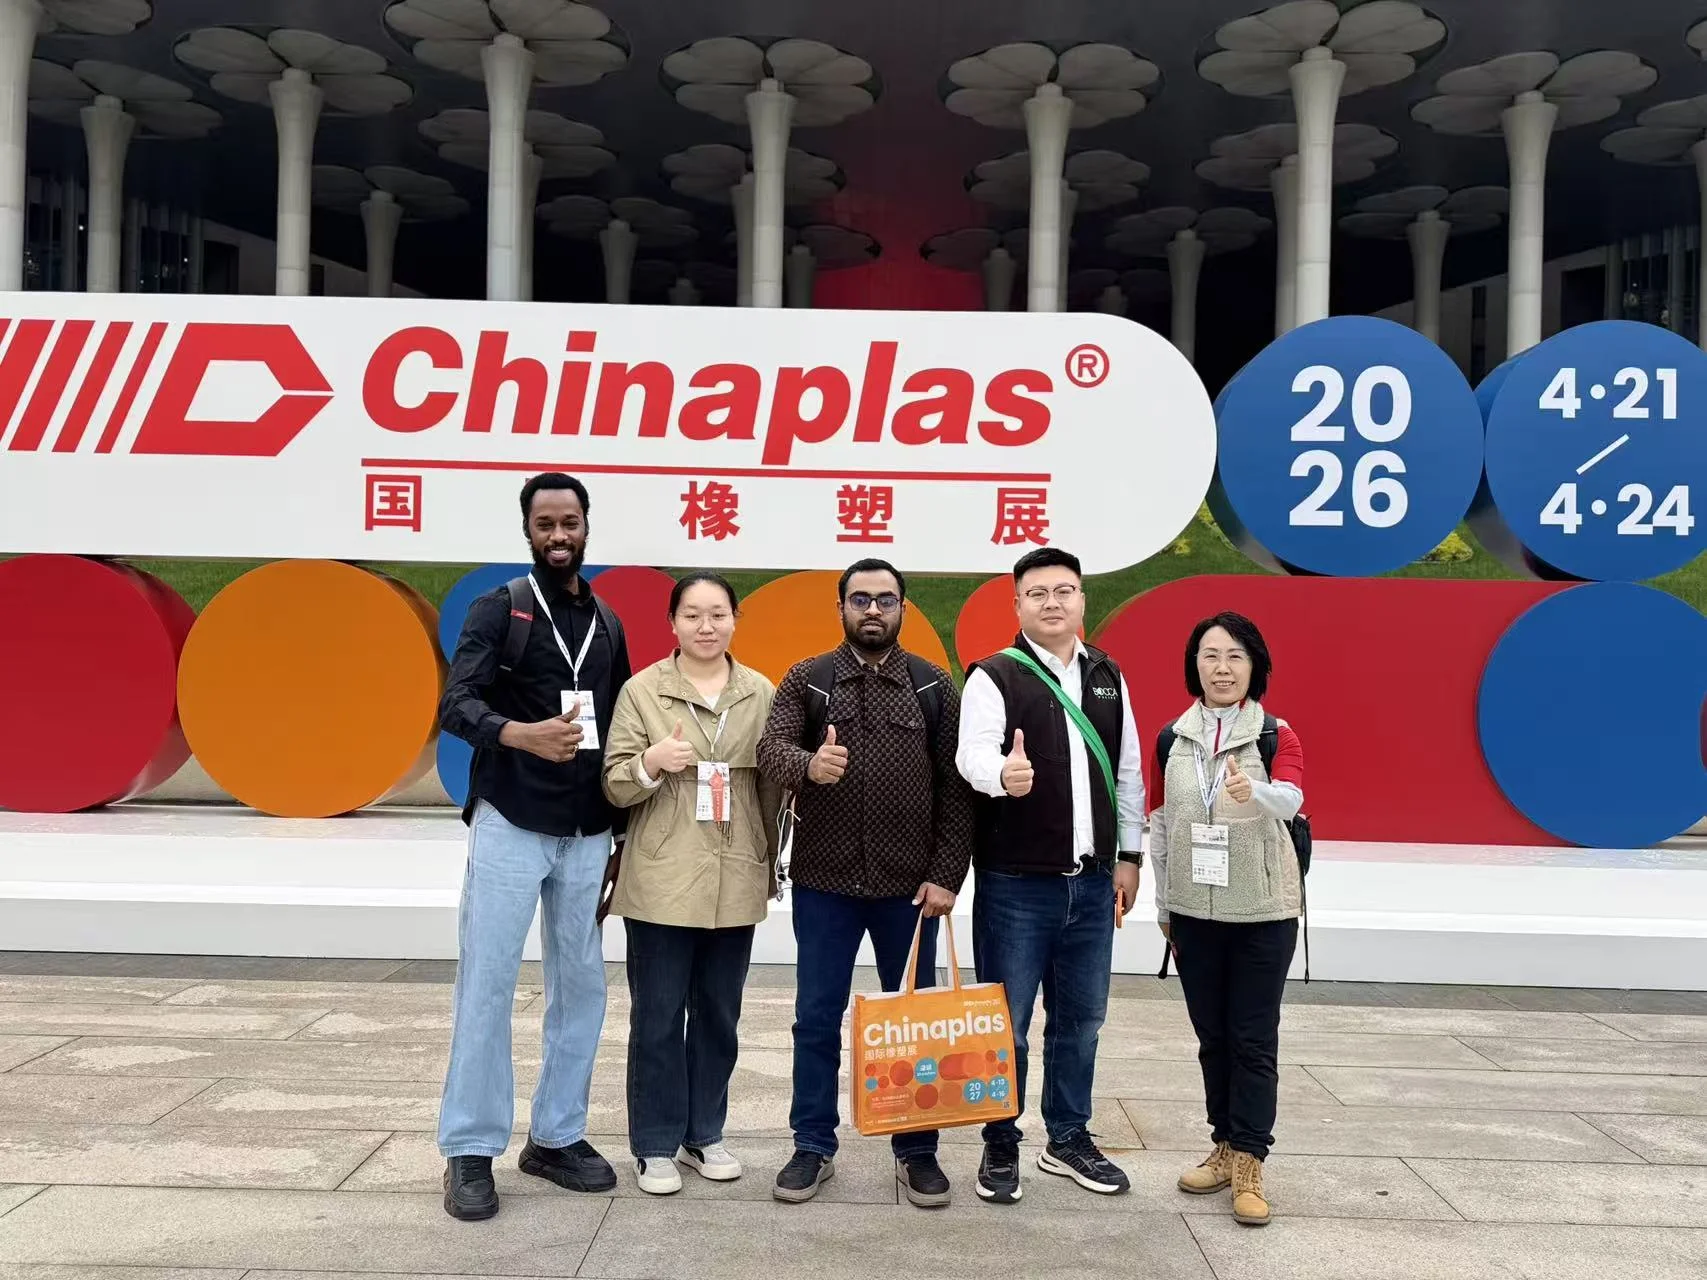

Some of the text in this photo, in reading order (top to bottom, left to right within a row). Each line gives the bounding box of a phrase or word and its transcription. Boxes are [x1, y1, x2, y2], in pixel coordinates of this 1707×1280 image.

[1290, 365, 1412, 443] 20
[1539, 366, 1678, 420] 4·21
[1289, 449, 1409, 528] 26
[1539, 482, 1696, 537] 4·24
[968, 1082, 982, 1092] 20
[969, 1091, 982, 1101] 27
